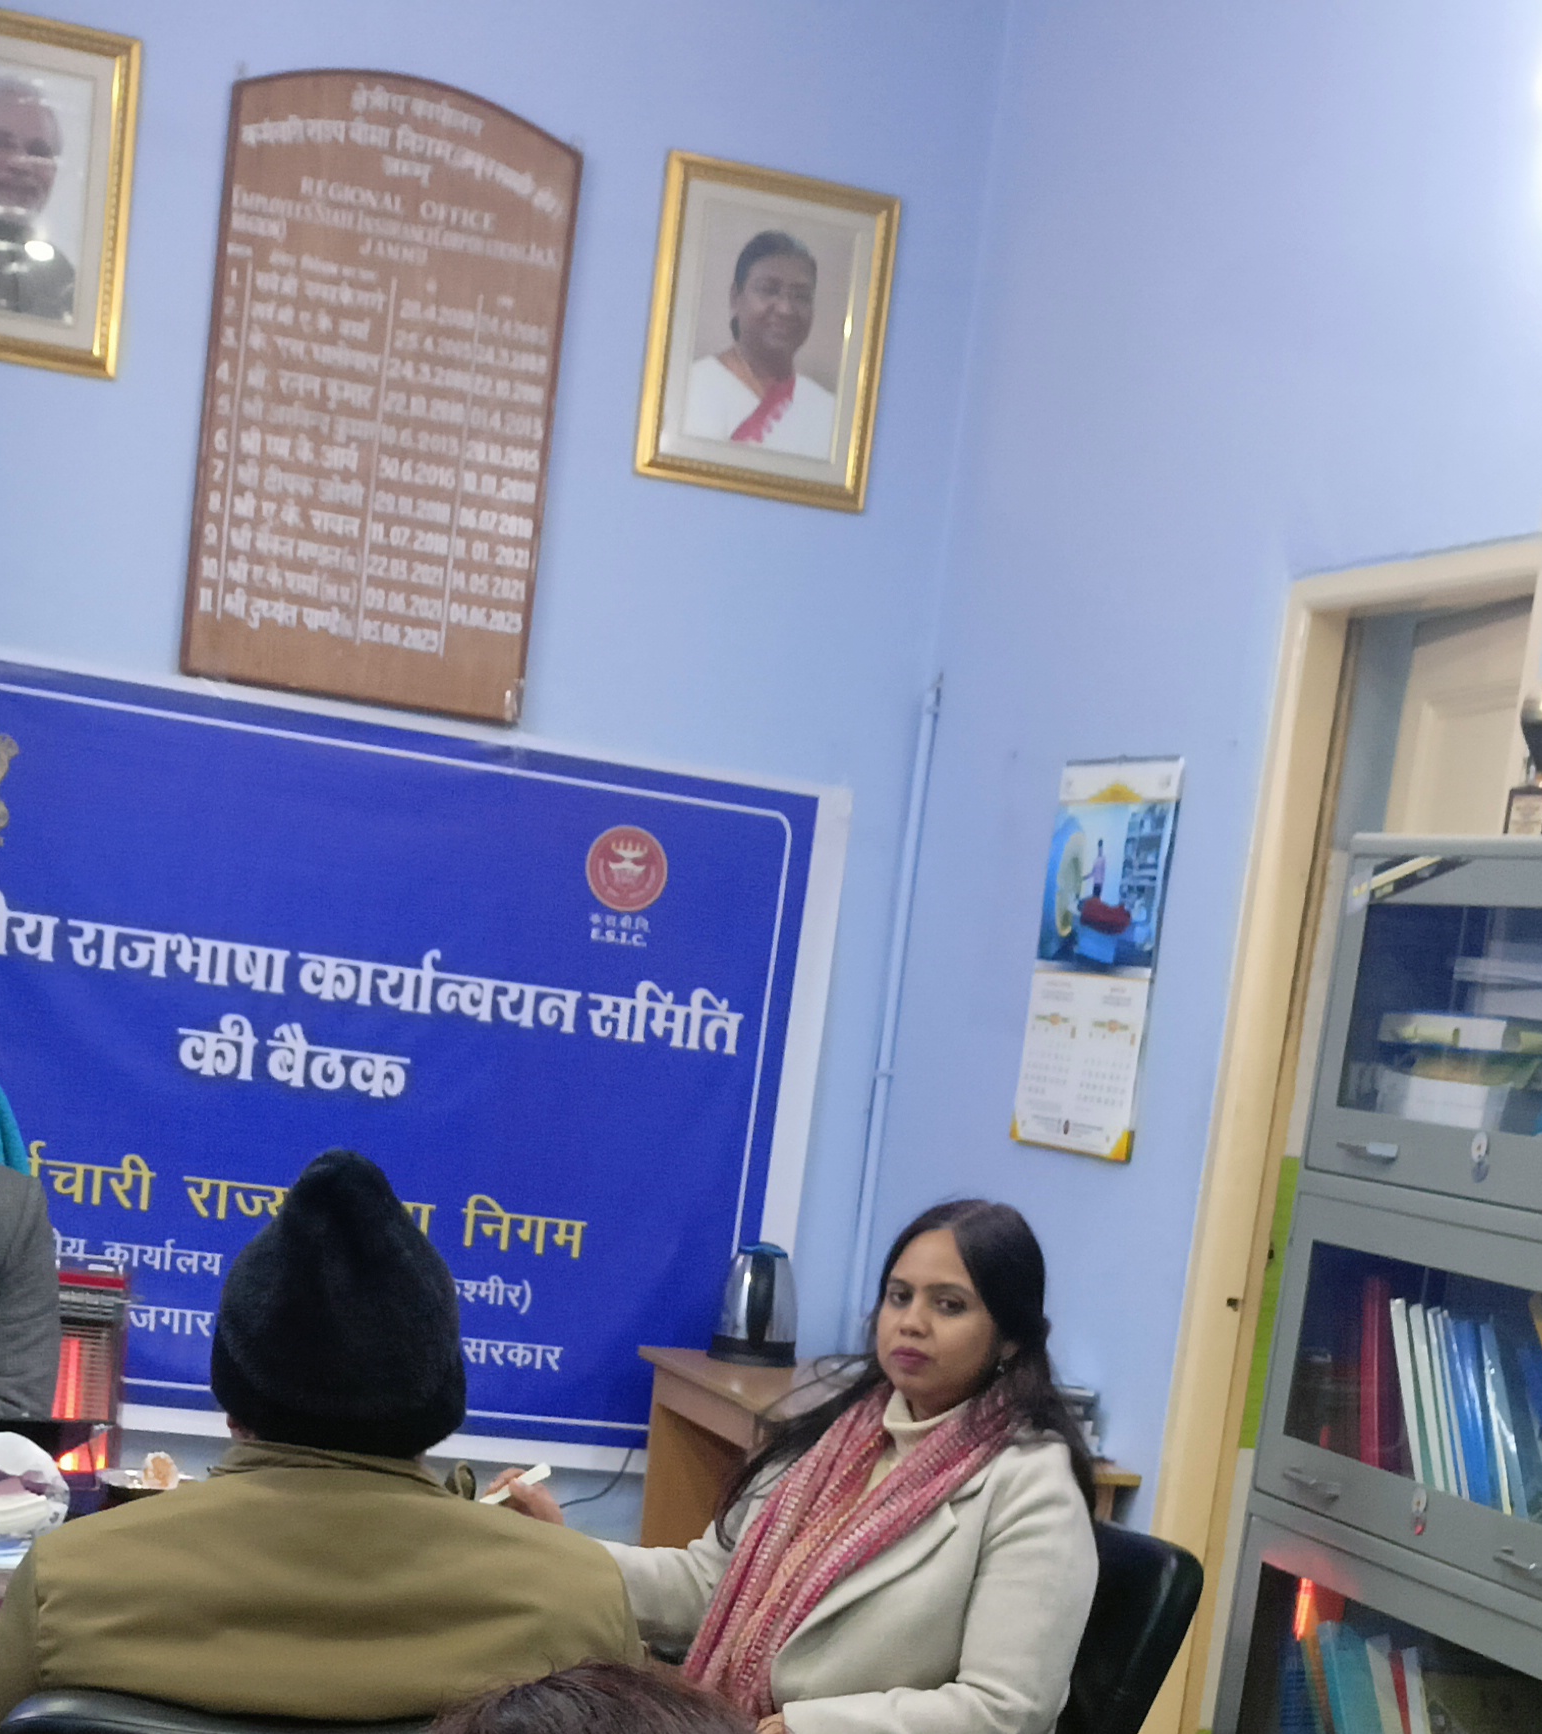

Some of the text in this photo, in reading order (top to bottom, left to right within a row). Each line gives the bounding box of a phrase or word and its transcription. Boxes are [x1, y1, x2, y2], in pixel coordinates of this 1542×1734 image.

[301, 176, 496, 233] REGIONAL OFFICE
[67, 919, 290, 994] राजभाषा
[297, 949, 581, 1033] कार्यान्वयन
[587, 980, 744, 1055] समिति
[178, 1013, 411, 1097] की बैठक
[103, 1238, 224, 1276] कार्यालय
[461, 1194, 588, 1259] निगम
[461, 1336, 564, 1371] सरकार
